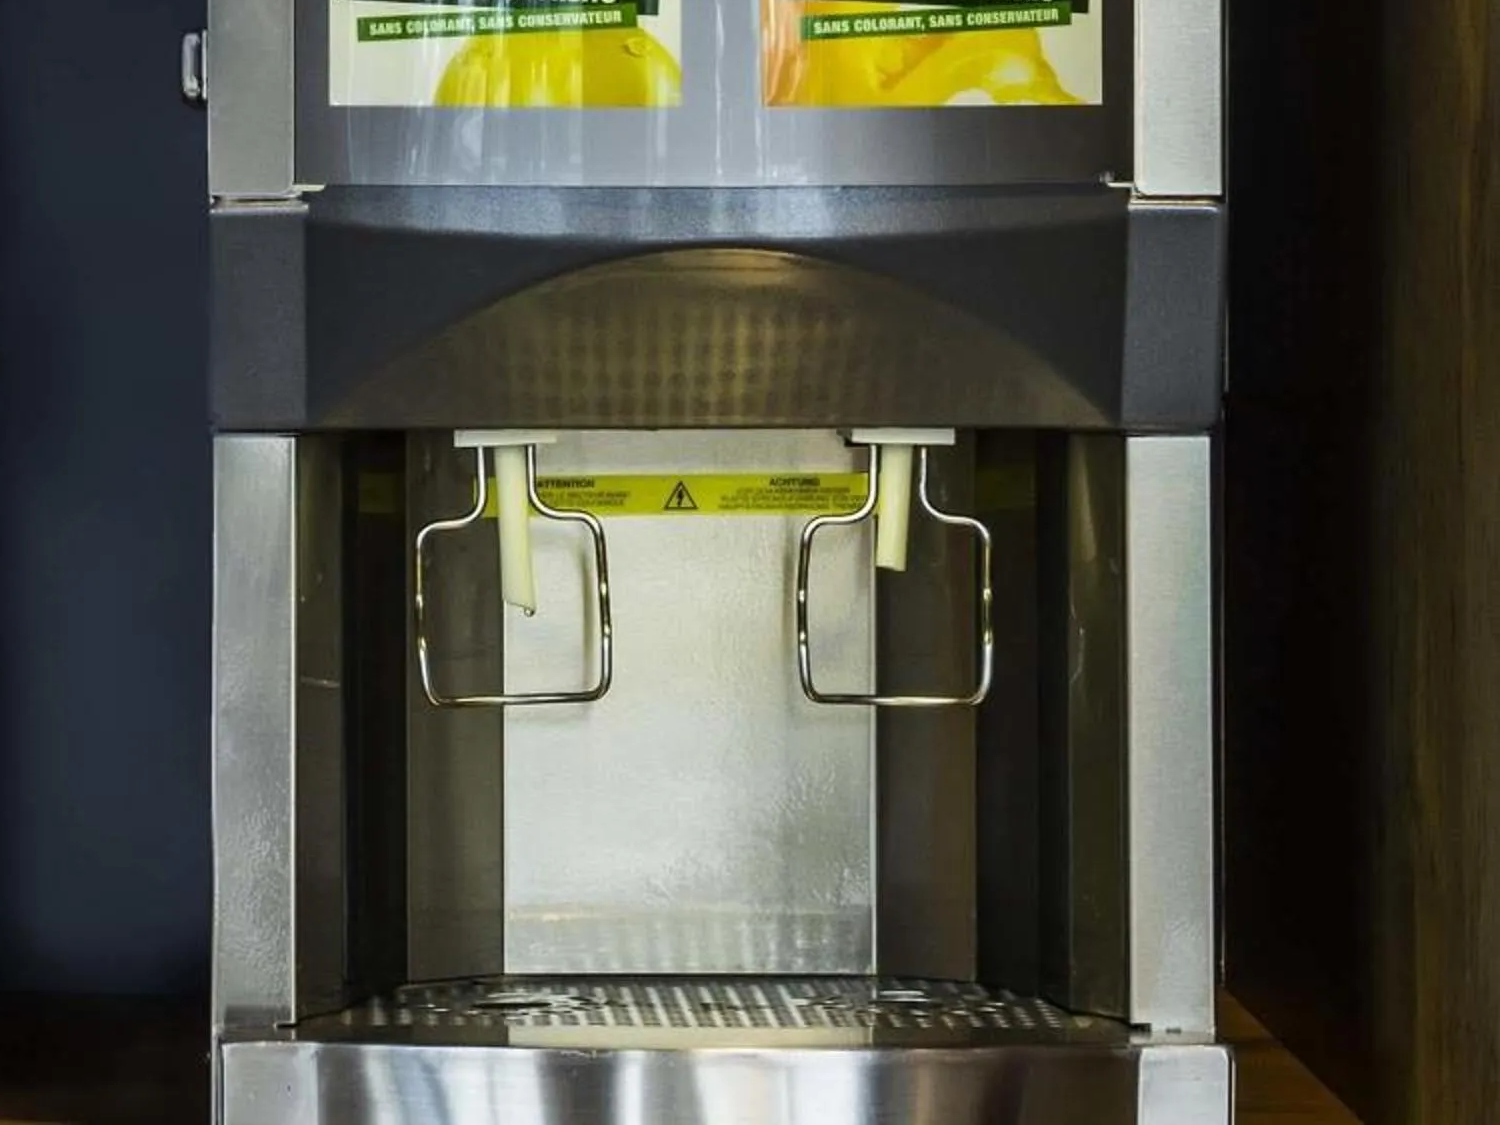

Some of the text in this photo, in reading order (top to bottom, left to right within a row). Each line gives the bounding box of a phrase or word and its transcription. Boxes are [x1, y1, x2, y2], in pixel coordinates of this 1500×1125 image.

[369, 22, 402, 36] SANS
[479, 15, 514, 30] SANS
[518, 9, 622, 28] CONSERVATEUR
[813, 21, 850, 35] SANS
[928, 13, 963, 29] SANS
[966, 8, 1059, 26] CONSERVATEUR
